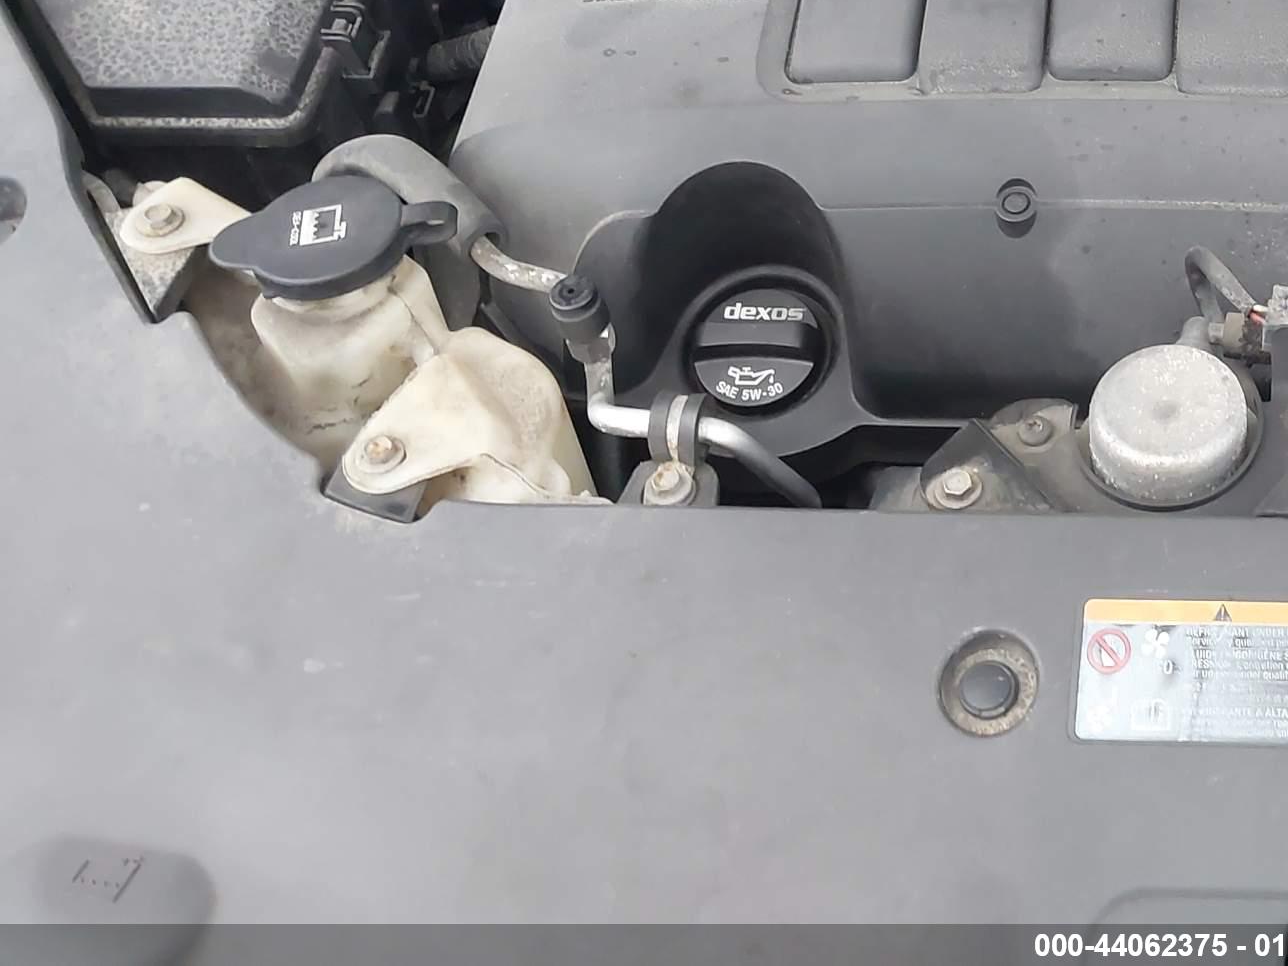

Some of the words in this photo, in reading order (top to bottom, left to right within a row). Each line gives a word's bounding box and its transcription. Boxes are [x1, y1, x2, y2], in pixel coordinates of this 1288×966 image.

[723, 302, 807, 321] dexos
[716, 381, 739, 400] SAE
[741, 382, 784, 401] 5W-30
